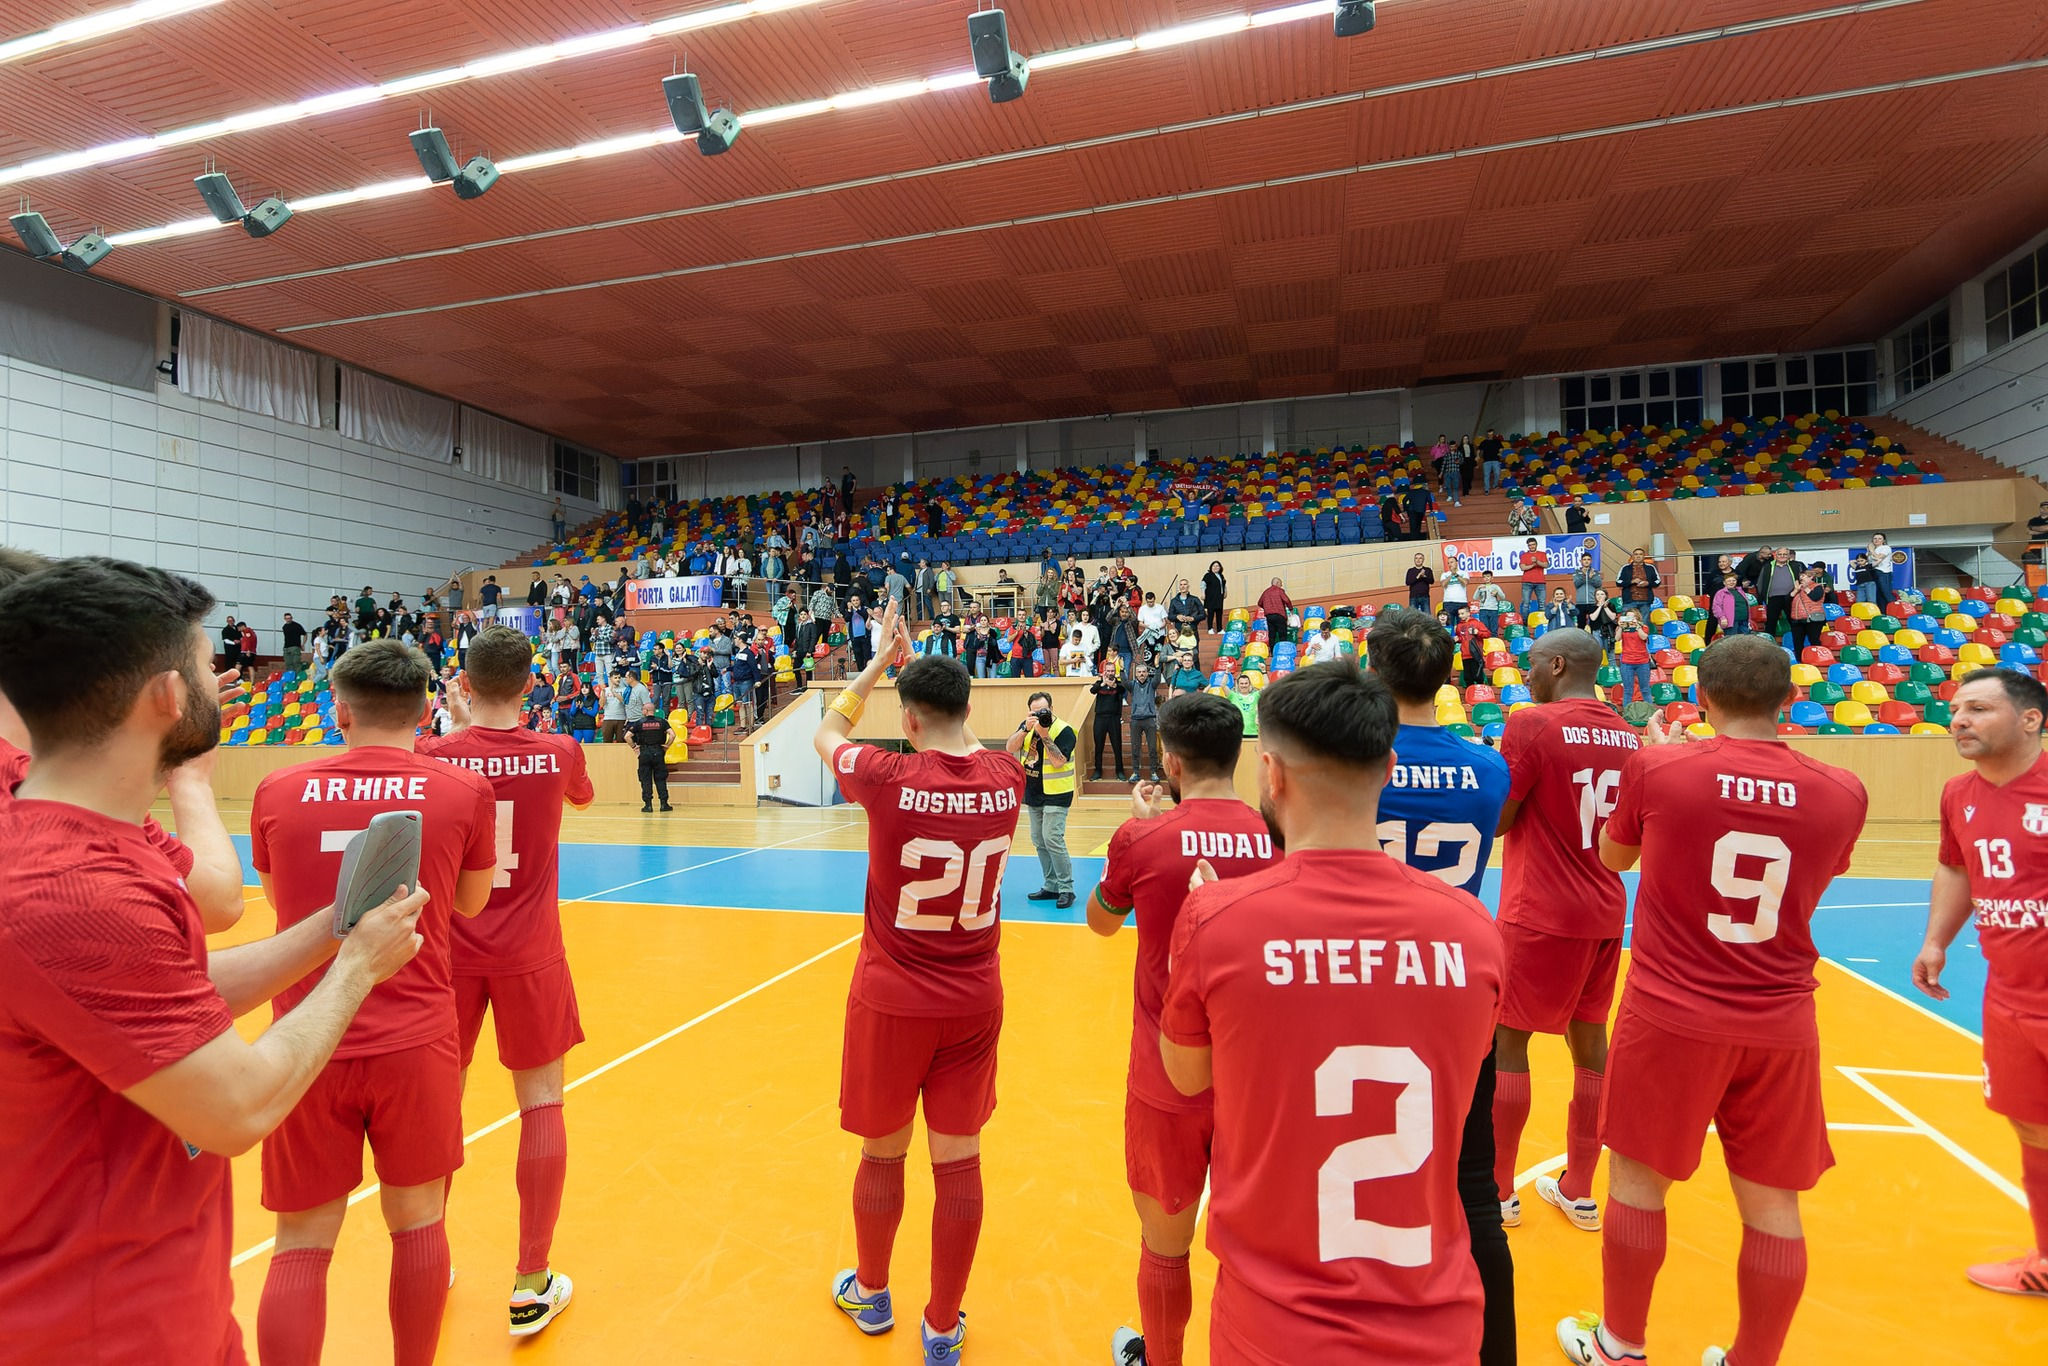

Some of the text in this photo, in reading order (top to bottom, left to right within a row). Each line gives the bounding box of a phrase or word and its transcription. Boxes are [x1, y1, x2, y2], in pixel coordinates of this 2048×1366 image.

[1458, 551, 1503, 571] Galeria
[1562, 726, 1639, 750] DOS SANTOS
[435, 753, 560, 777] URDUJEL
[1392, 765, 1480, 790] ONITA
[301, 777, 428, 803] ARHIRE
[898, 786, 1017, 814] BOSNEAGA
[1716, 773, 1797, 808] TOTO
[1181, 830, 1273, 859] DUDAU
[1974, 838, 2016, 879] 13
[894, 834, 1012, 932] 20
[1707, 830, 1792, 943] 9
[1975, 898, 2048, 913] PRIMARI
[1263, 939, 1467, 988] STEFAN
[1314, 1044, 1434, 1268] 2
